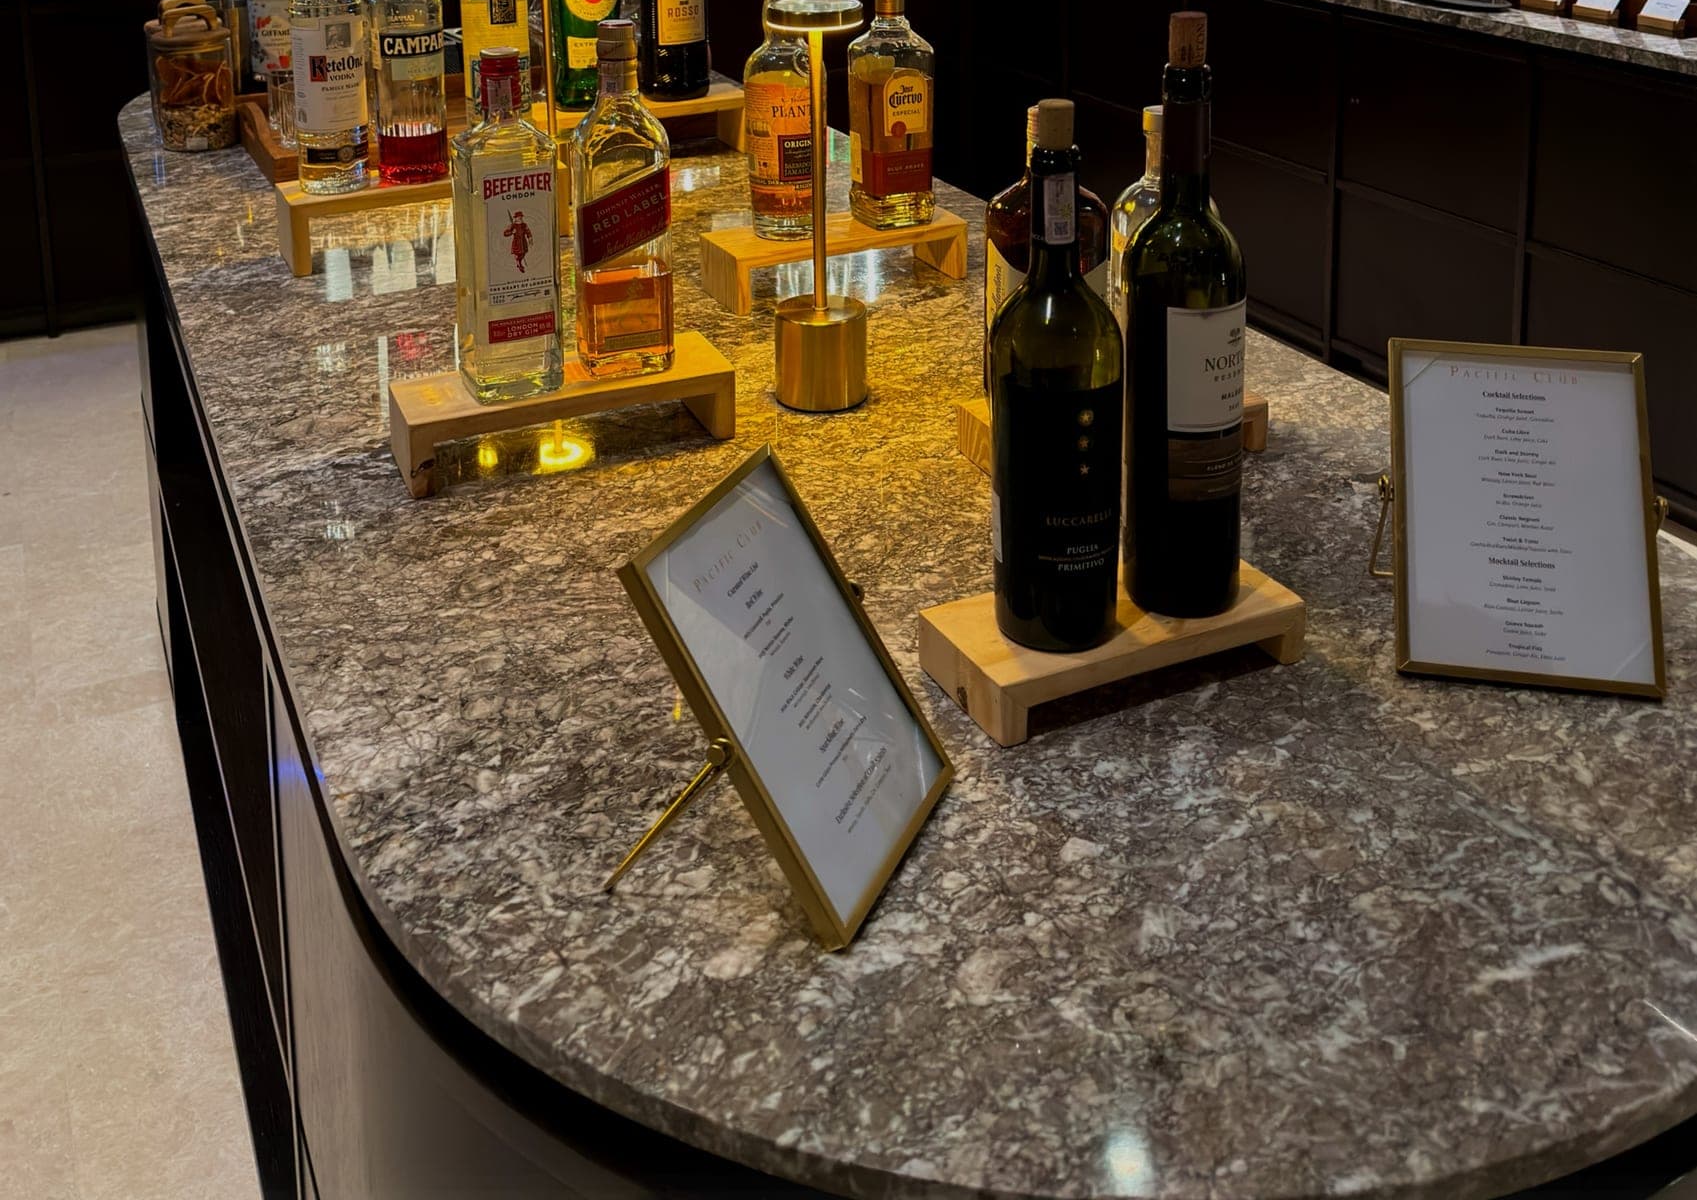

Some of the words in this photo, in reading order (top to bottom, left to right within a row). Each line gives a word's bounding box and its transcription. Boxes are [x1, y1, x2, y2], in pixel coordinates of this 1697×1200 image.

[667, 5, 699, 18] ROSSO
[383, 31, 444, 55] CAMPAR
[310, 56, 345, 81] Ketel
[329, 72, 355, 81] VODKA
[889, 92, 922, 108] Cuervo
[784, 139, 812, 148] ORIGIN
[484, 172, 552, 200] BEEFEATER
[502, 191, 535, 200] LONDON
[592, 214, 621, 233] RED
[623, 192, 666, 218] LABEL
[507, 322, 538, 332] LONDON
[1204, 351, 1243, 372] NORT
[1482, 391, 1511, 400] Cocktail
[1511, 392, 1546, 401] Selections
[1066, 544, 1098, 555] PUGLIA
[1057, 558, 1105, 571] PRIMITIVO
[1488, 557, 1519, 566] Mocktail
[1520, 559, 1556, 569] Selections
